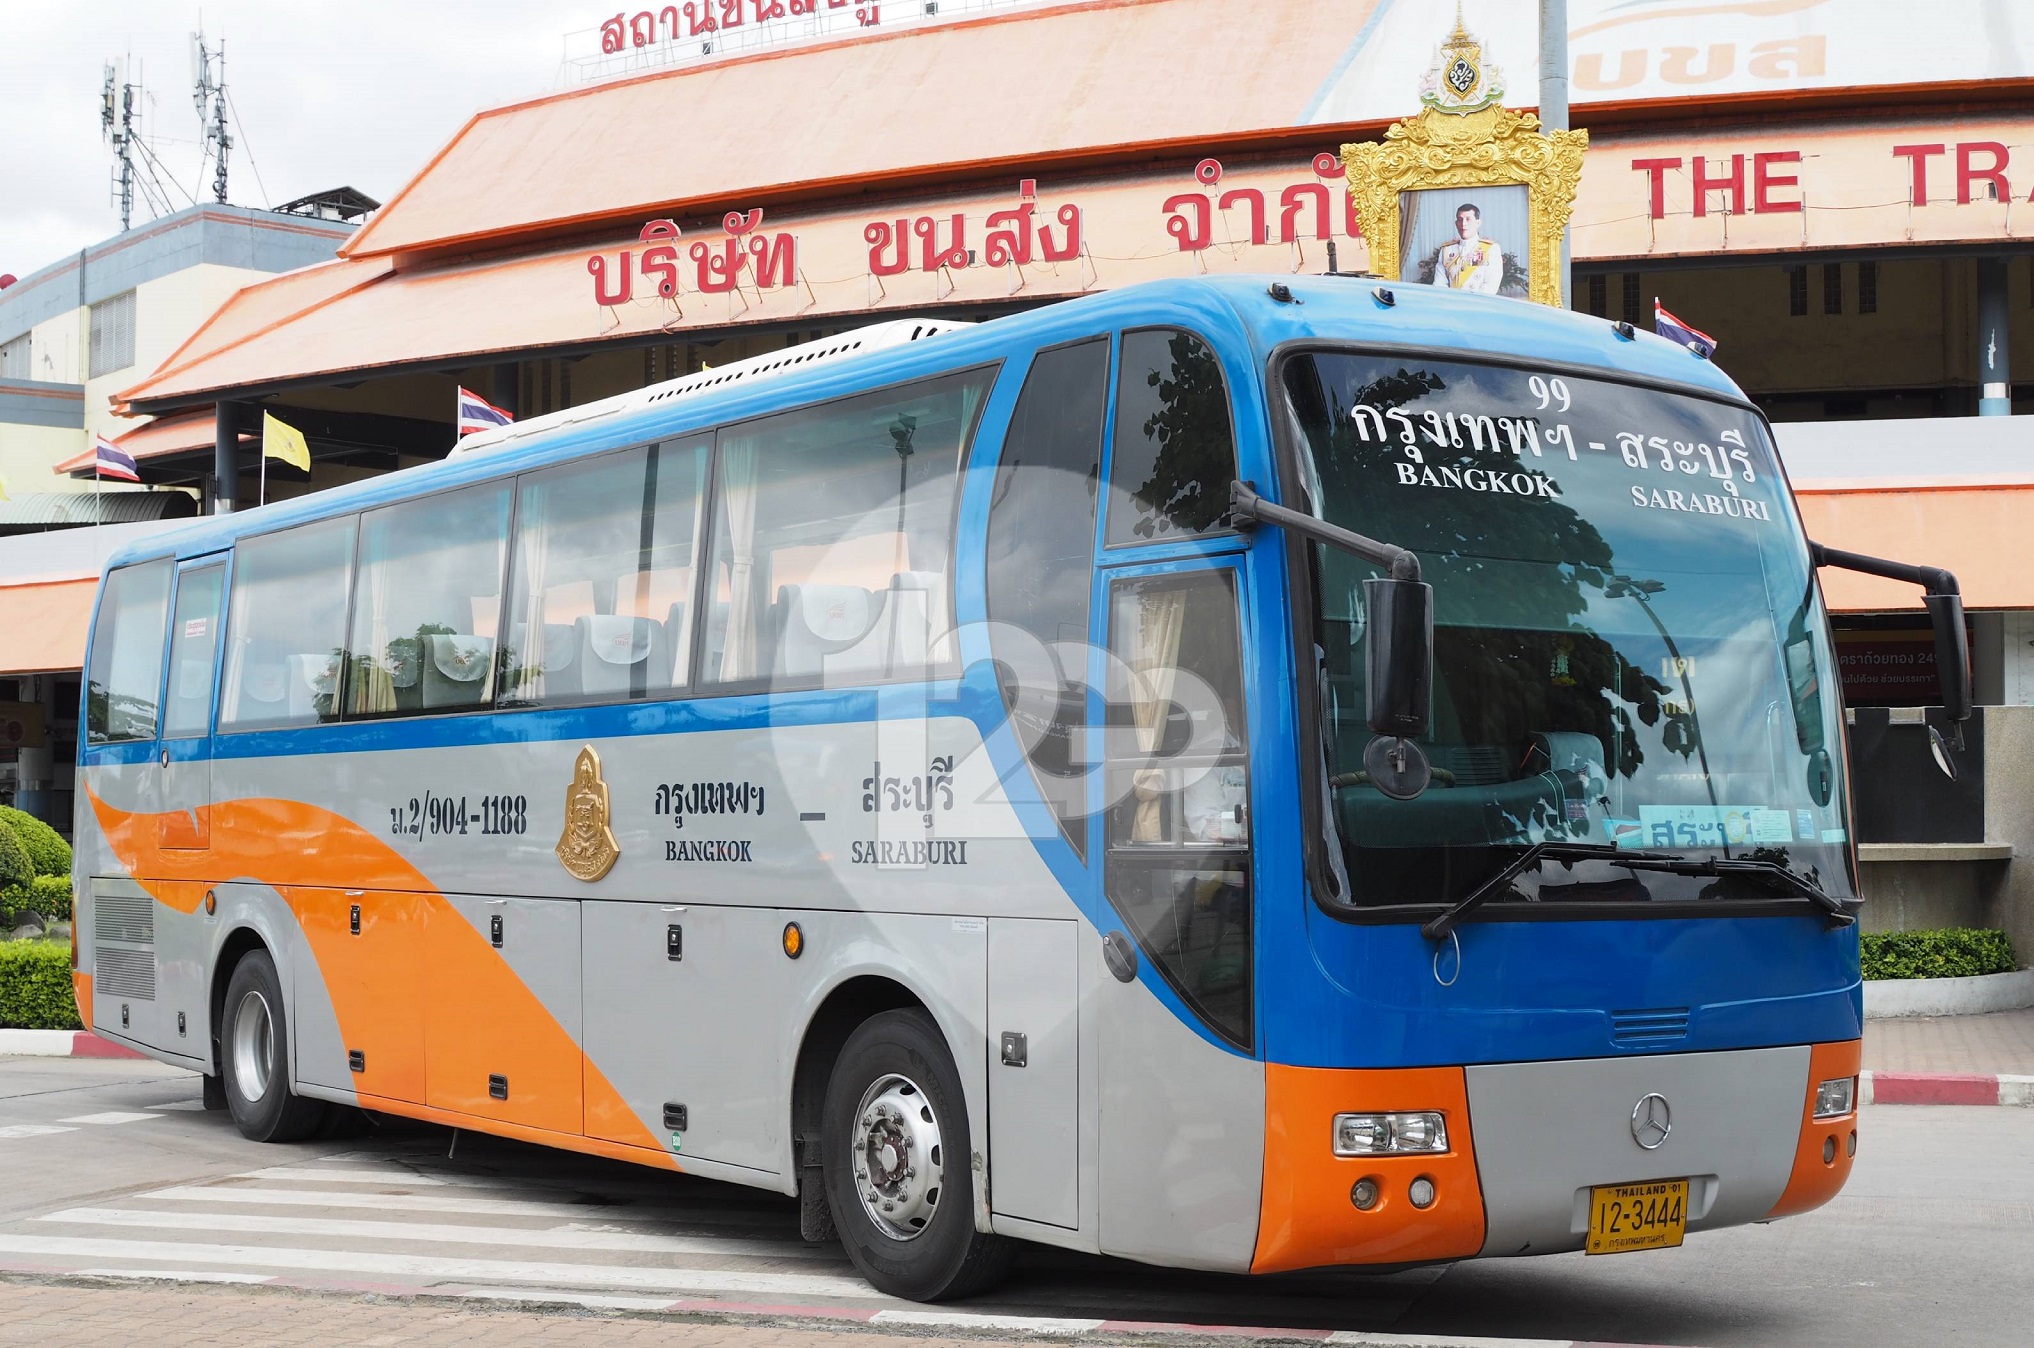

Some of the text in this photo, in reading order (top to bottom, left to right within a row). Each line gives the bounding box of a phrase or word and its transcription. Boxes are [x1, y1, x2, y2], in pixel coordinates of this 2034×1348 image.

[1631, 141, 2034, 220] THE TR
[587, 207, 799, 307] บริษัท
[863, 178, 1084, 277] ขนส่ง
[1527, 374, 1571, 414] 99
[1350, 403, 1579, 464] กรุงเทพฯ
[1615, 428, 1757, 497] สระบุรี
[1394, 462, 1772, 523] BANGKOK SARABURI
[390, 789, 528, 843] ม.2/904-1188
[654, 781, 766, 830] กรุงเทพฯ
[861, 755, 954, 829] สระบุรี
[665, 839, 968, 865] BANGKOK SARABURI
[1599, 1195, 1682, 1235] 12-3444
[1615, 1187, 1666, 1199] THAILAND
